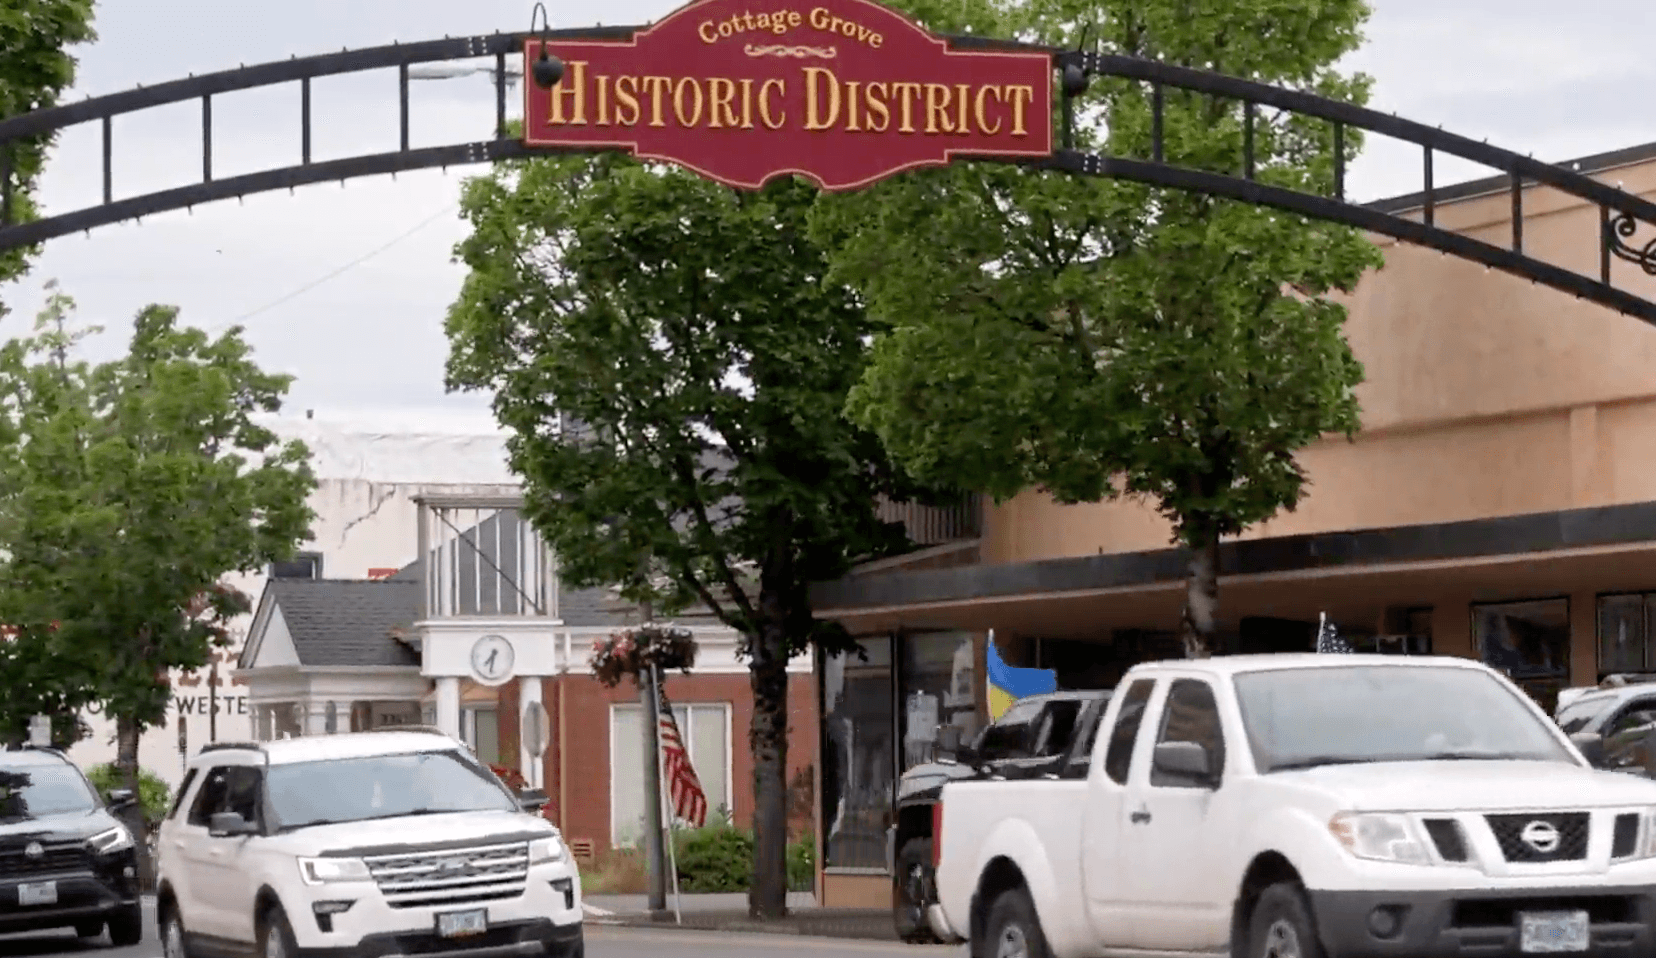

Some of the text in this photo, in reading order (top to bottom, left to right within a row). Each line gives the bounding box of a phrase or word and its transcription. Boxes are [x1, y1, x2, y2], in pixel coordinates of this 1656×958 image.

[698, 7, 883, 48] Cottage Grove
[547, 60, 1034, 135] HISTORIC DISTRICT
